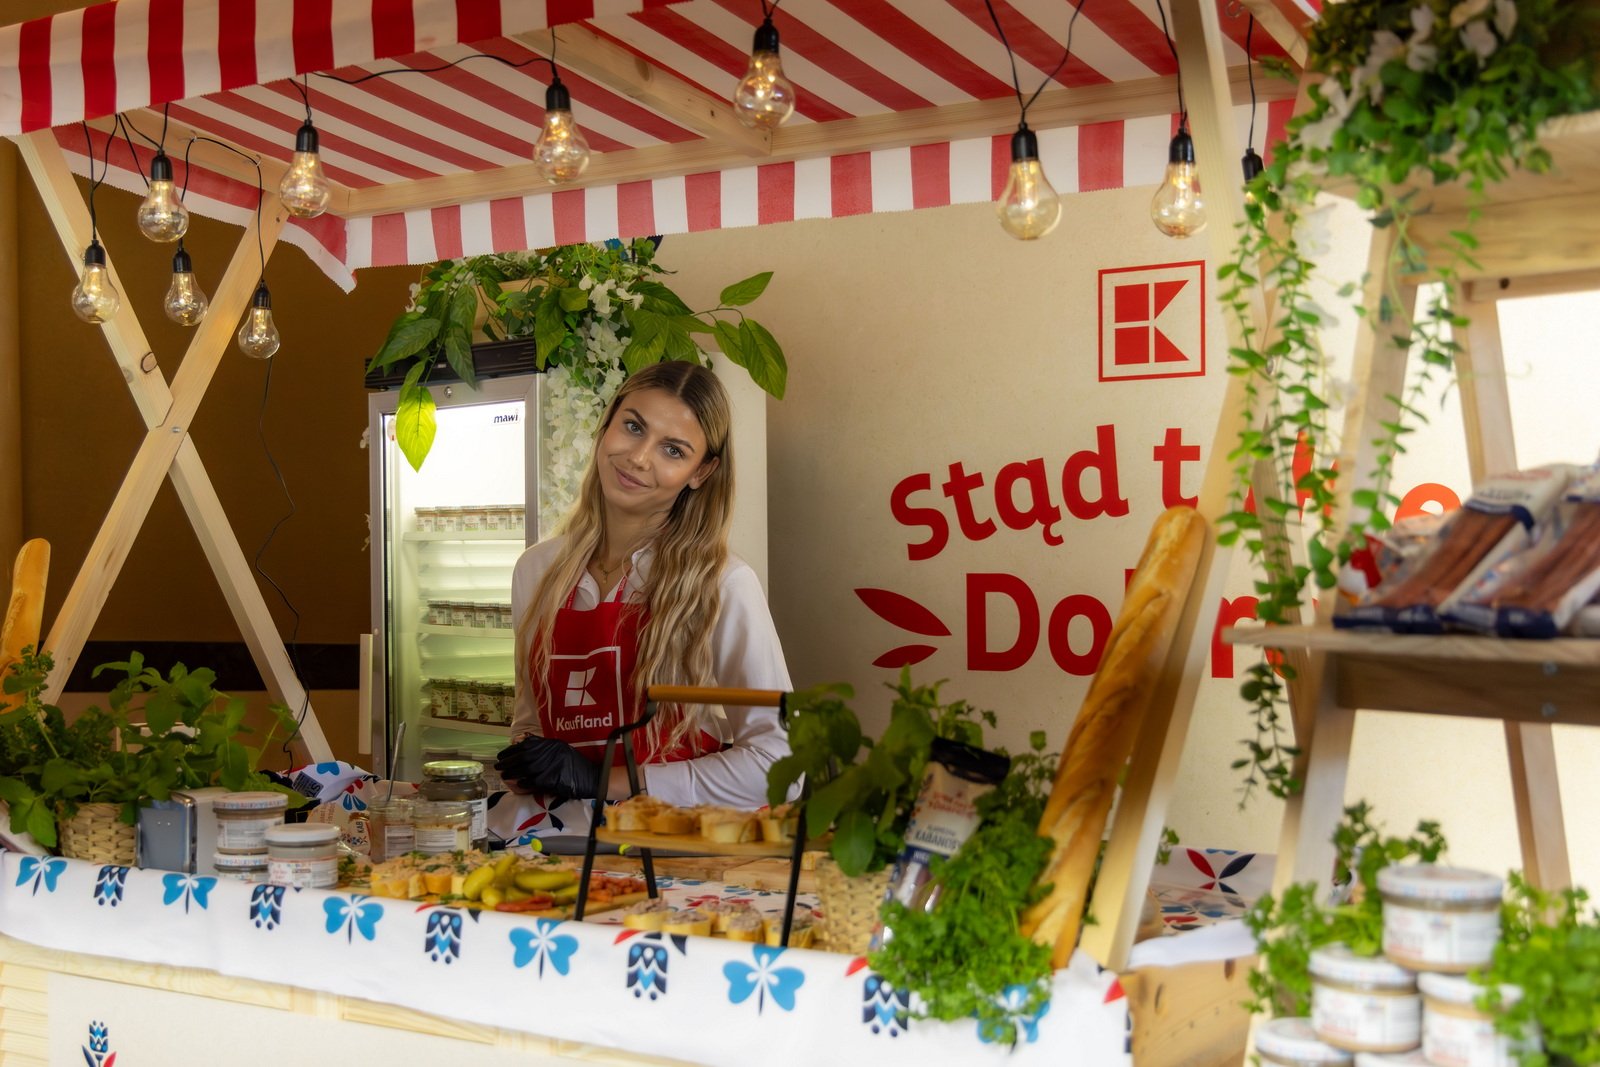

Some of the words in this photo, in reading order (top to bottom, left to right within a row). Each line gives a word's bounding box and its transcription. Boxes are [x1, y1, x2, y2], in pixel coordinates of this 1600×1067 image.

[493, 413, 518, 424] mawi
[890, 423, 1130, 561] Stąd
[555, 712, 613, 731] Kaufland
